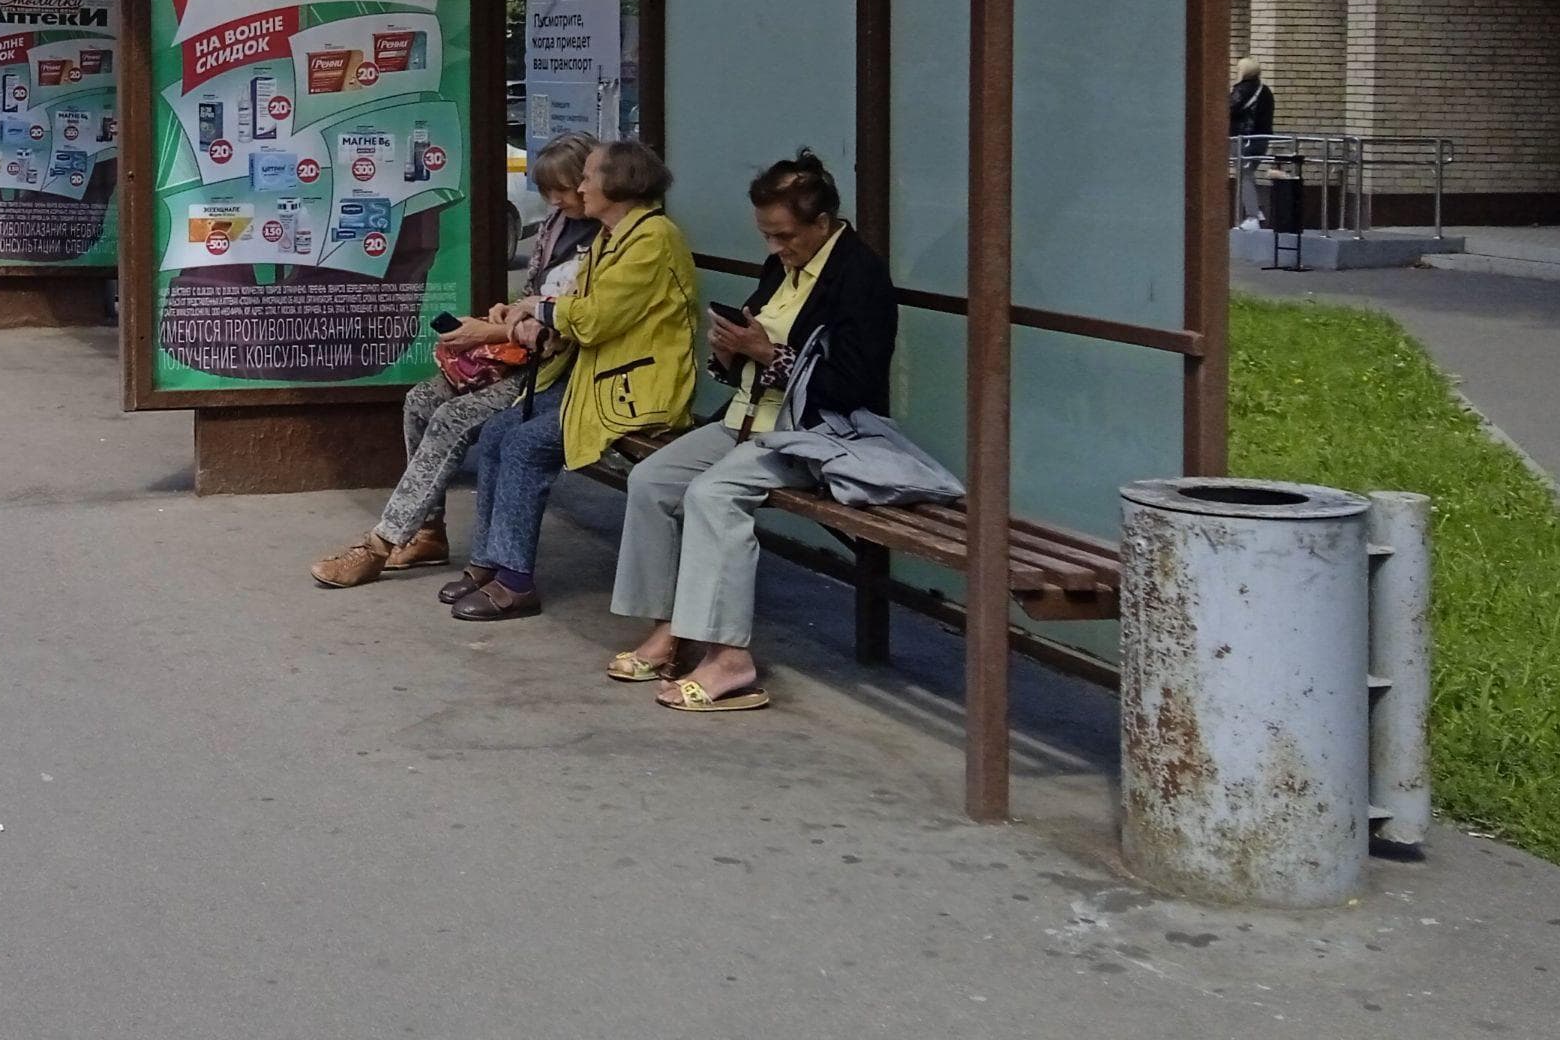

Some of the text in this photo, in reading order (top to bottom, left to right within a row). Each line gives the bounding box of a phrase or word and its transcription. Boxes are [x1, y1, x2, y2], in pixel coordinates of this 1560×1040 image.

[195, 15, 284, 56] НА ВОЛНЕ
[532, 35, 591, 51] когда приедет
[195, 37, 270, 75] СКИДОК
[533, 57, 593, 74] ваш транспорт
[342, 136, 377, 146] МАГНЕ
[158, 320, 221, 344] ИМЕЮТСЯ
[224, 316, 365, 343] ПРОТИВОПОКАЗАНИЯ.
[158, 346, 238, 371] ПОЛУЧЕНИЕ
[245, 343, 353, 369] КОНСУЛЬТАЦИИ
